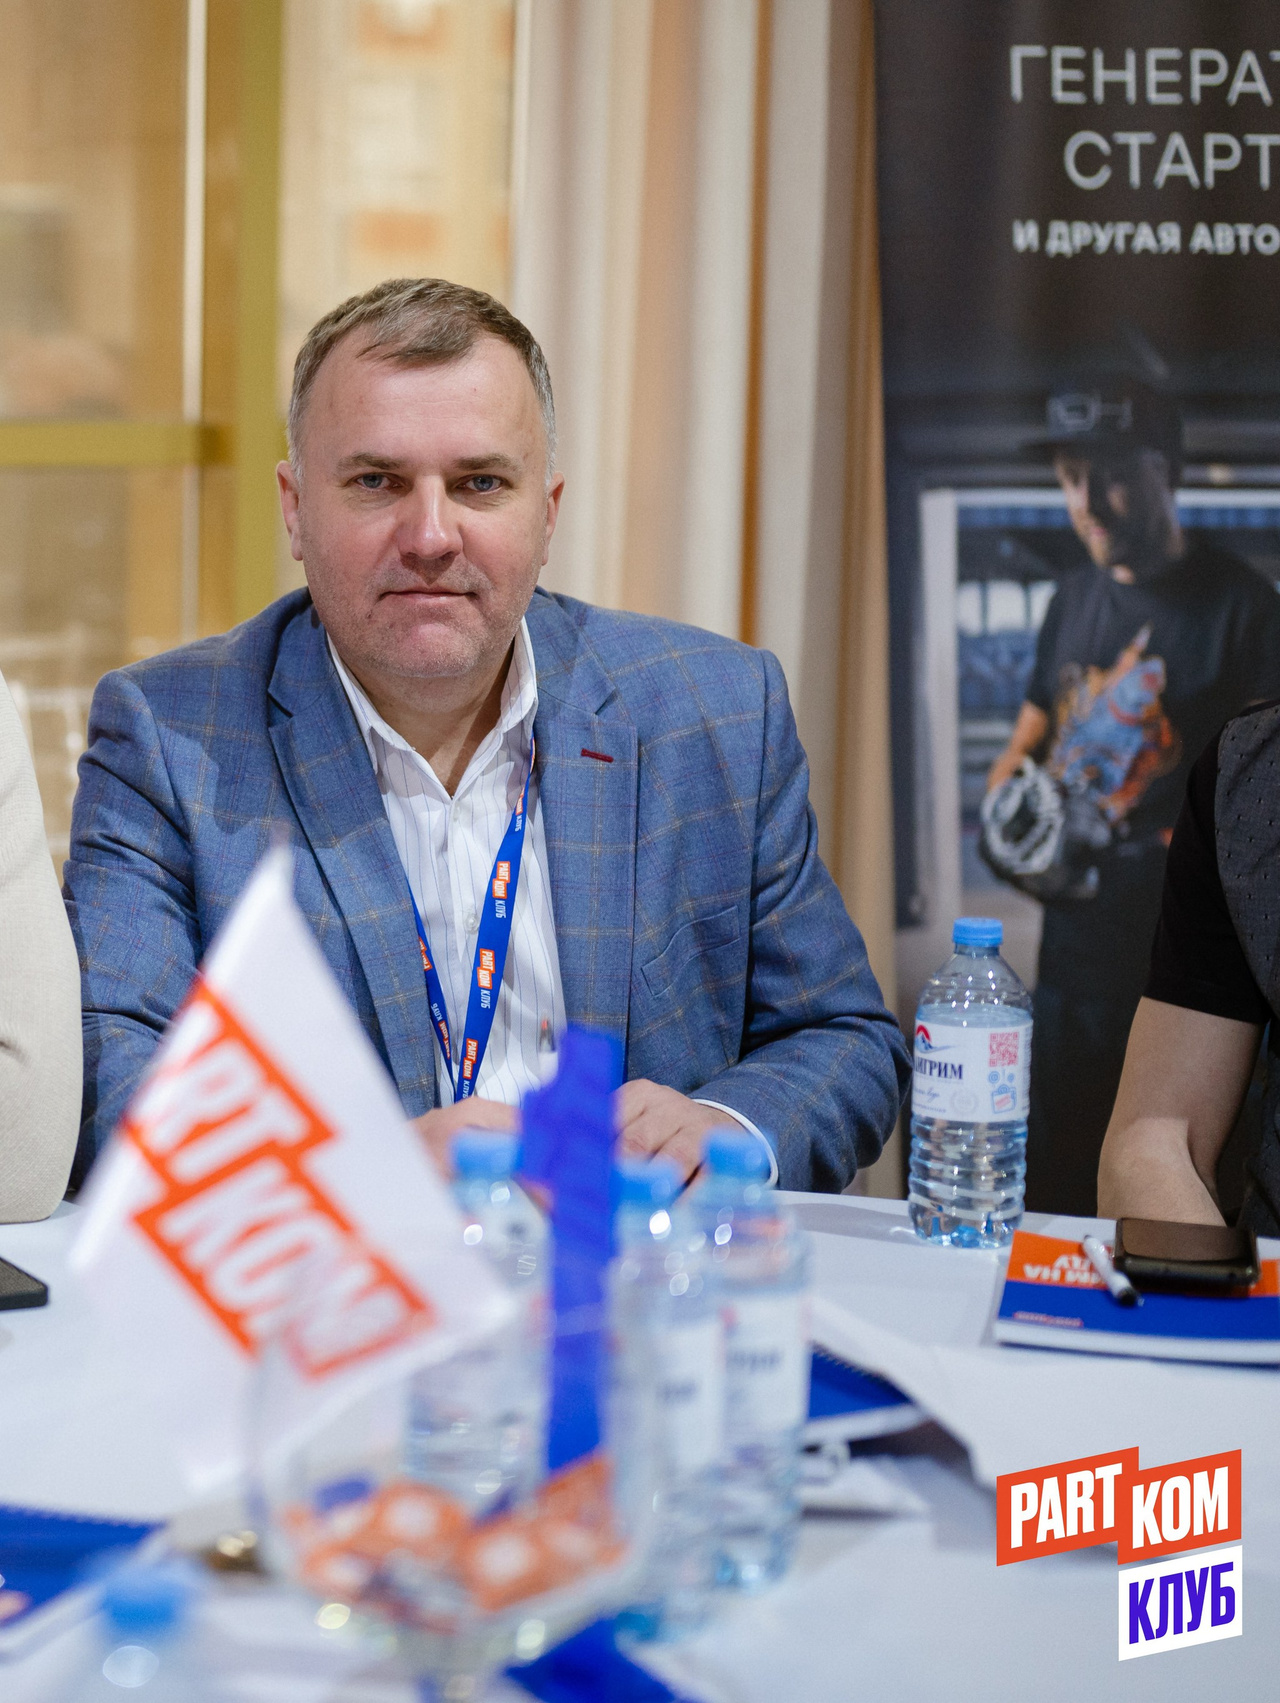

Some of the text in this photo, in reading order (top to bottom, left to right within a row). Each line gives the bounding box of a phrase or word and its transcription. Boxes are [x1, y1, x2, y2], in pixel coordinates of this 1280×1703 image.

[1010, 45, 1280, 106] ГЕНЕРА
[1064, 130, 1280, 190] СТАРТ
[1013, 219, 1280, 258] И ДРУГАЯ АВТО
[498, 863, 509, 881] PART
[495, 899, 507, 918] КЛУБ
[481, 950, 494, 971] PART
[480, 989, 491, 1009] КЛУБ
[467, 1040, 477, 1061] PART
